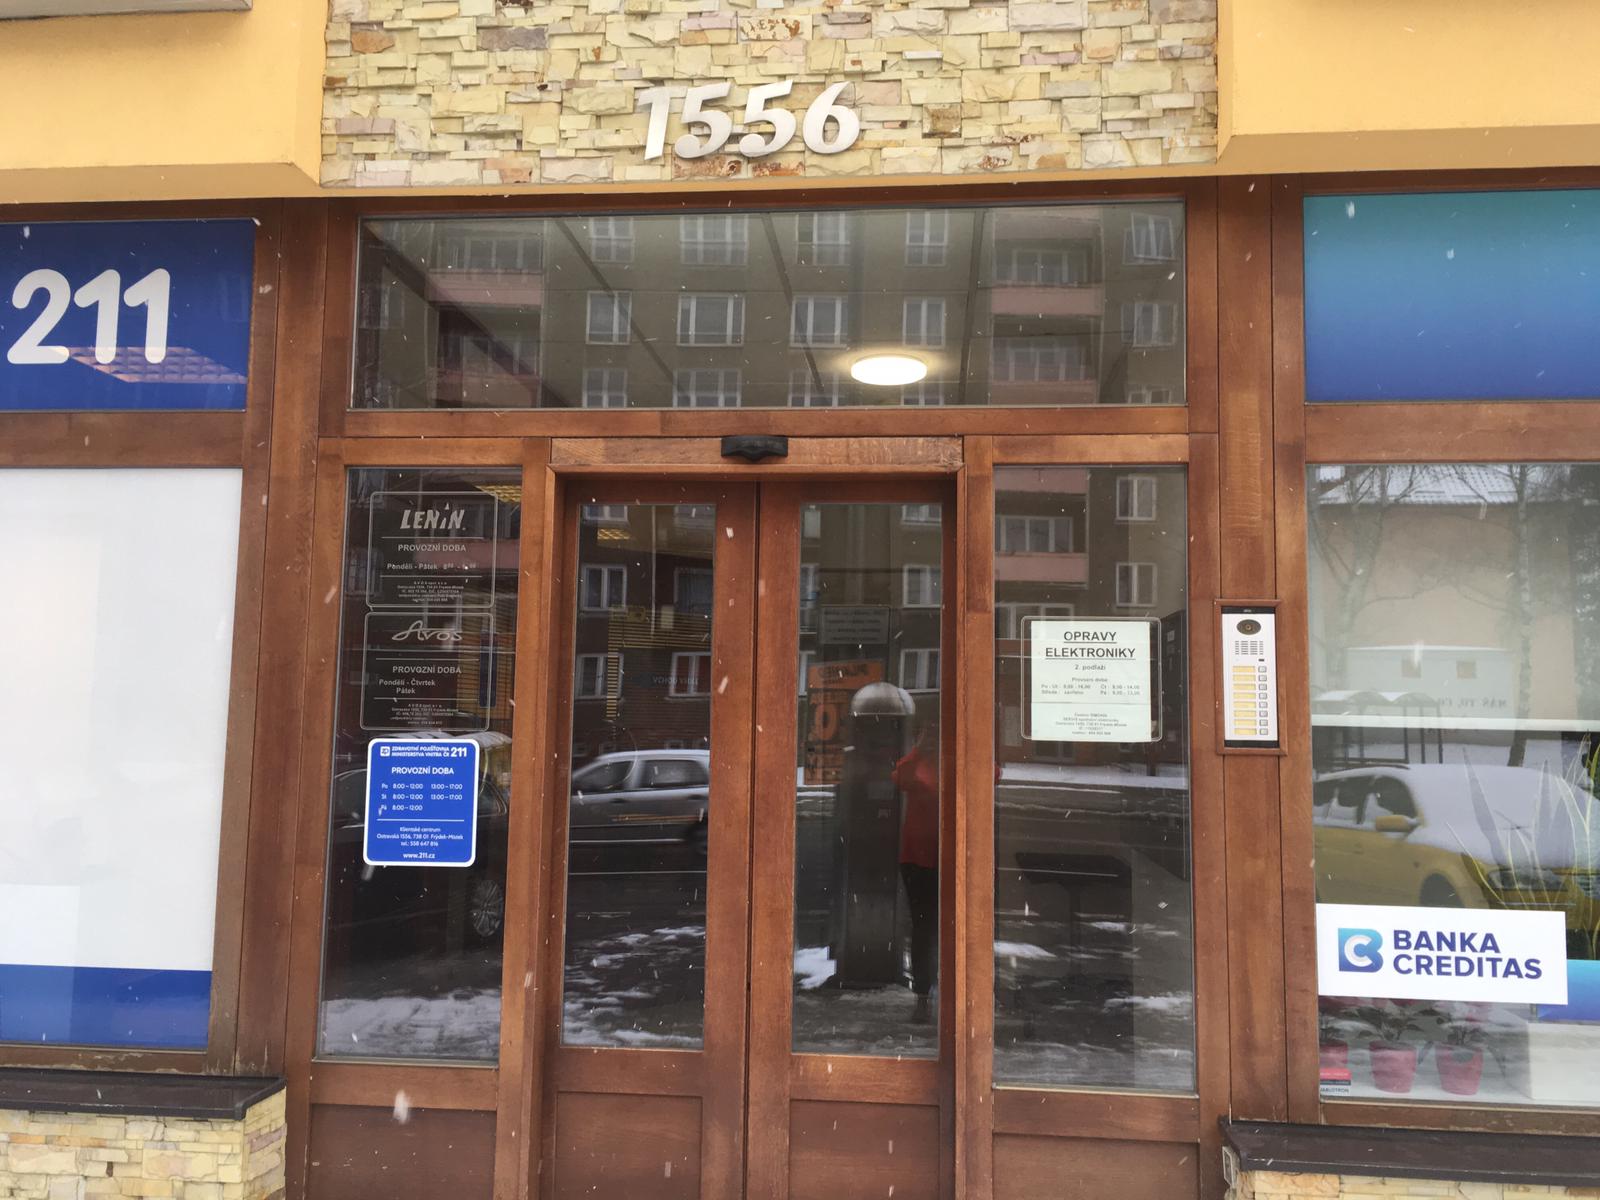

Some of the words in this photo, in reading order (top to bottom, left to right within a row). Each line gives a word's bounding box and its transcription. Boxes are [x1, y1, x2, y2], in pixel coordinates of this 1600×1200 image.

[637, 79, 860, 160] 1556
[7, 268, 170, 365] 211
[398, 543, 440, 552] PROVOZNÍ
[442, 544, 466, 552] DOBA
[1063, 631, 1117, 641] OPRAVY
[1045, 647, 1136, 658] ELEKTRONIKY
[392, 665, 436, 674] PROVOZNÍ
[437, 666, 462, 674] DOBA
[410, 678, 436, 686] Čtvrtek
[450, 746, 468, 758] 211
[391, 765, 431, 774] PROVOZNÍ
[432, 766, 455, 775] DOBA
[1393, 929, 1501, 953] BANKA
[1393, 953, 1543, 980] CREDITAS
